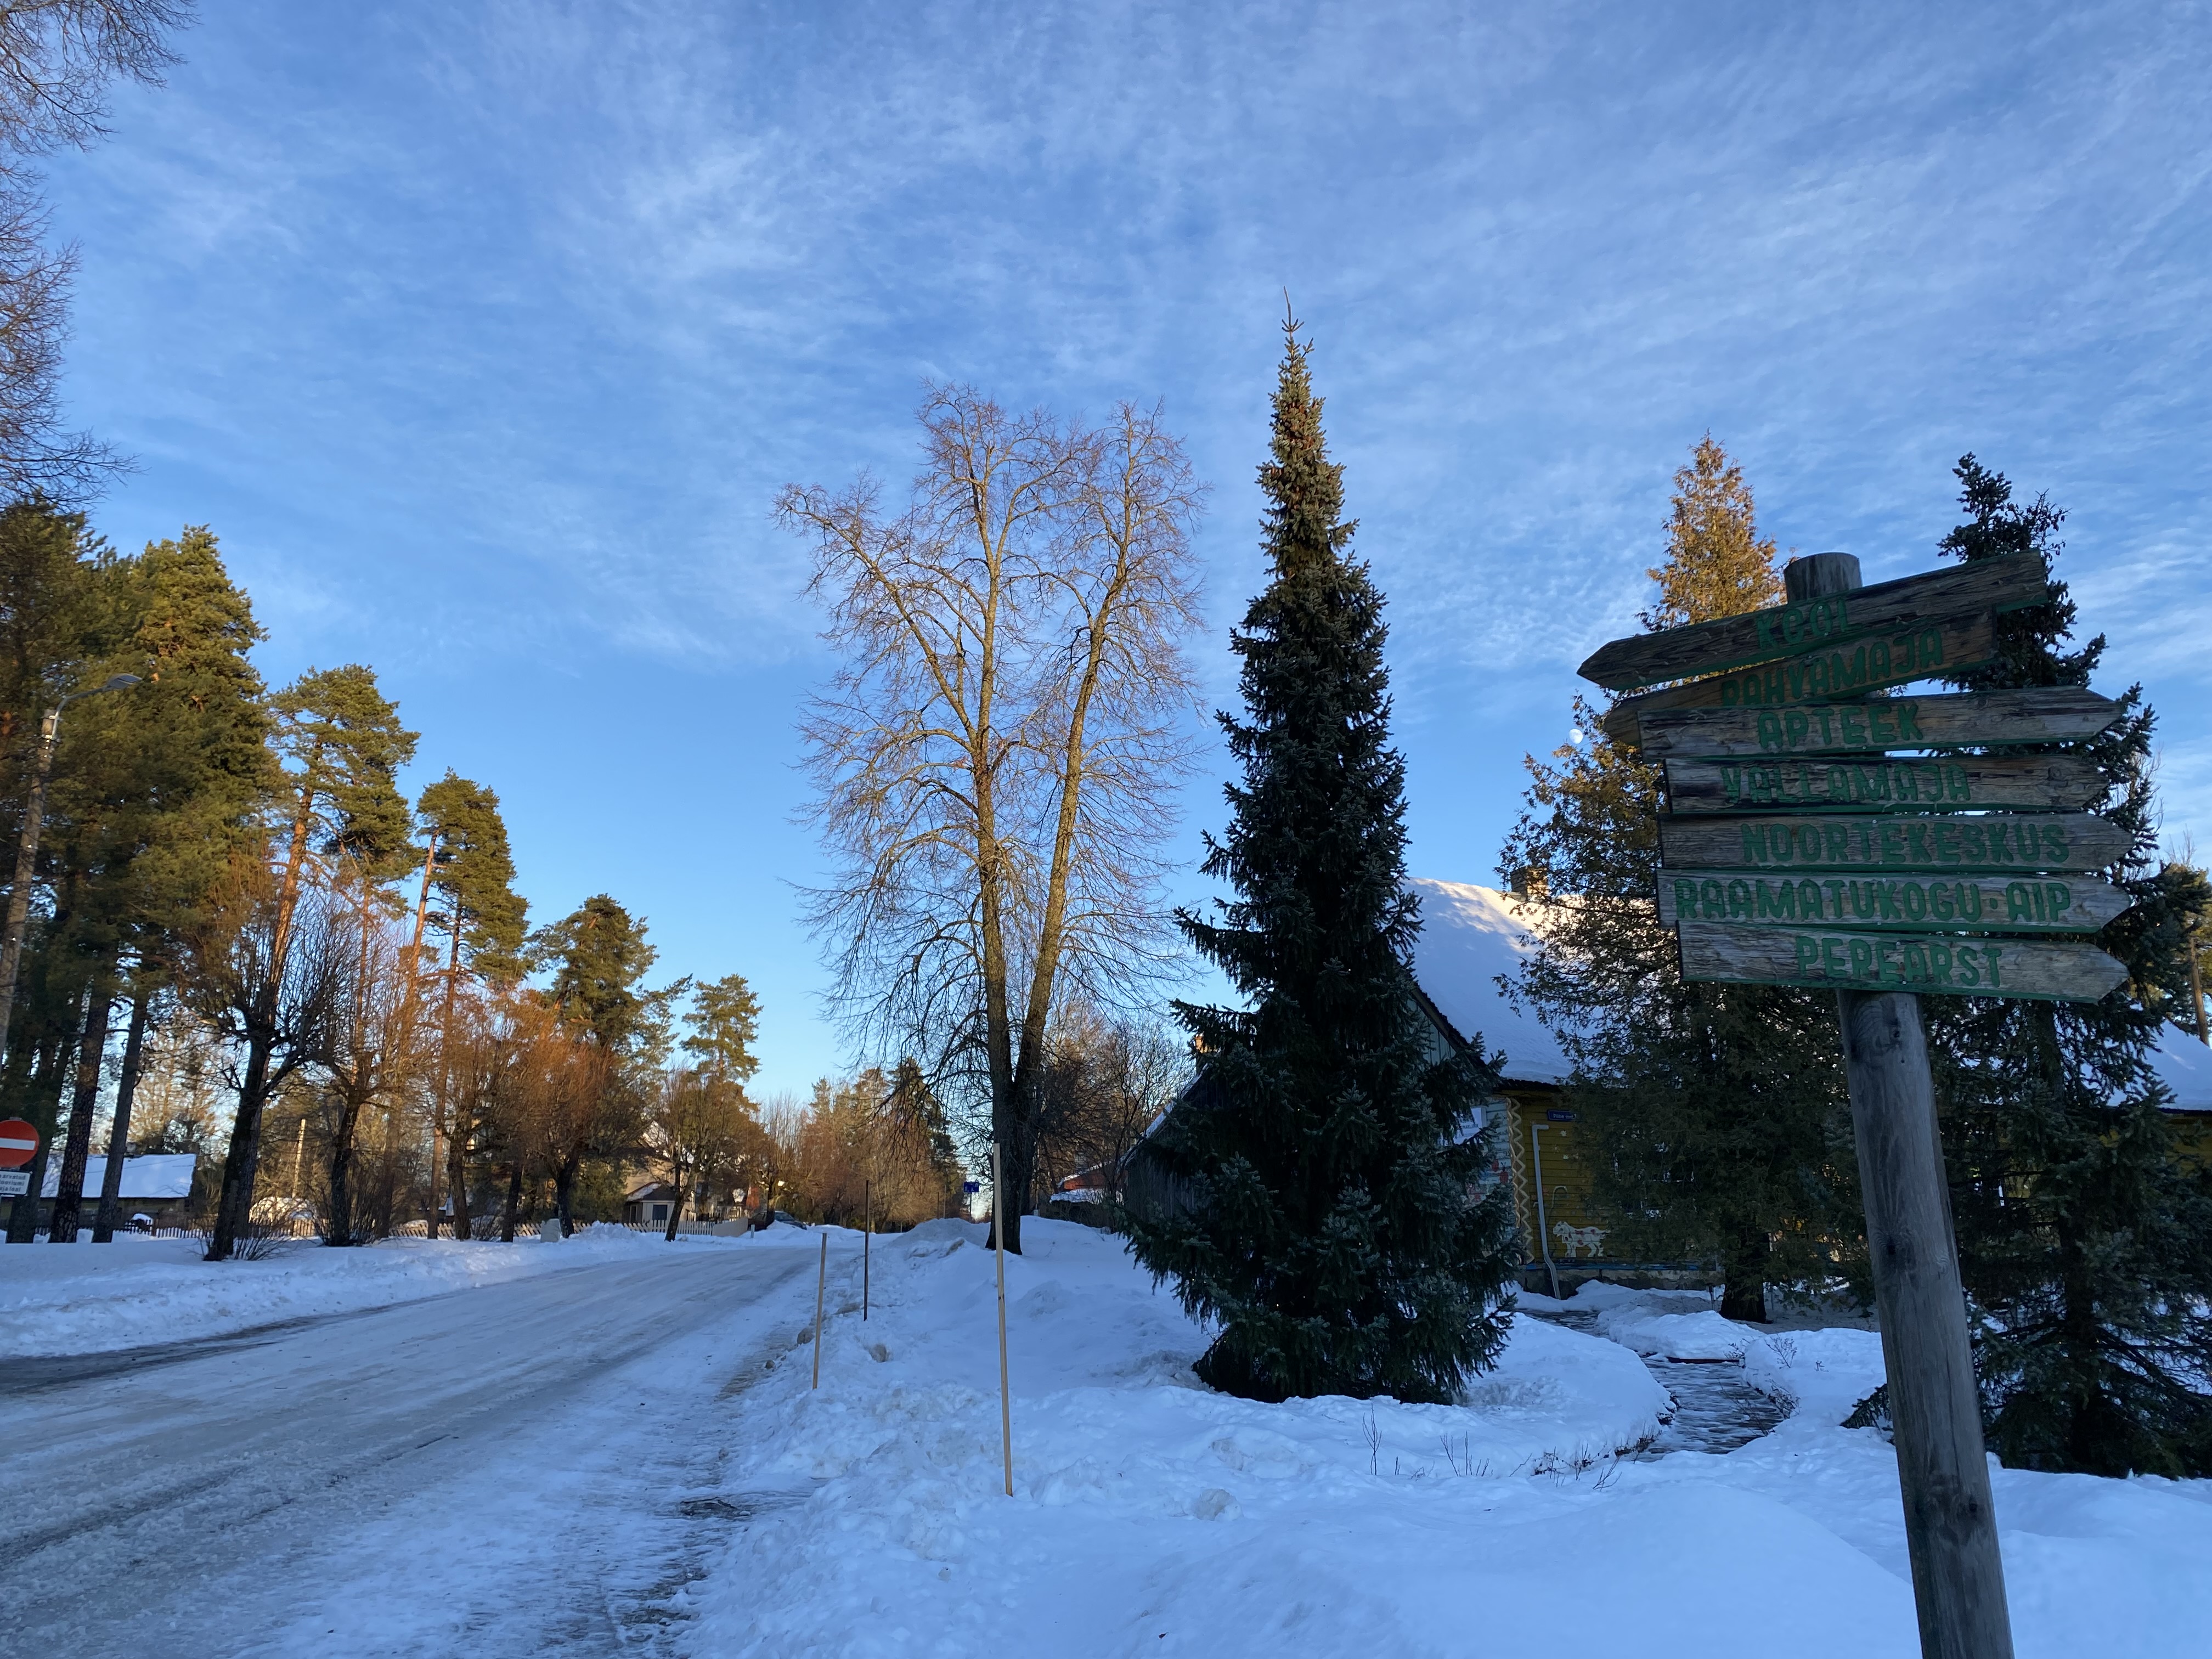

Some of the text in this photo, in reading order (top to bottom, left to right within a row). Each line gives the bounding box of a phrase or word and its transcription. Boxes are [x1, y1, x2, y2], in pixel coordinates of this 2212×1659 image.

[1757, 602, 1863, 651] KOOL
[1721, 628, 1943, 706] RAHVAMAJA
[1757, 704, 1923, 749] APTEEK
[1720, 764, 1971, 804] VALLAMAJA
[1741, 823, 2069, 864] NOORTEKESKUS
[1674, 879, 1982, 922] RAAMATUKOGU
[1796, 936, 2002, 987] PEREARST
